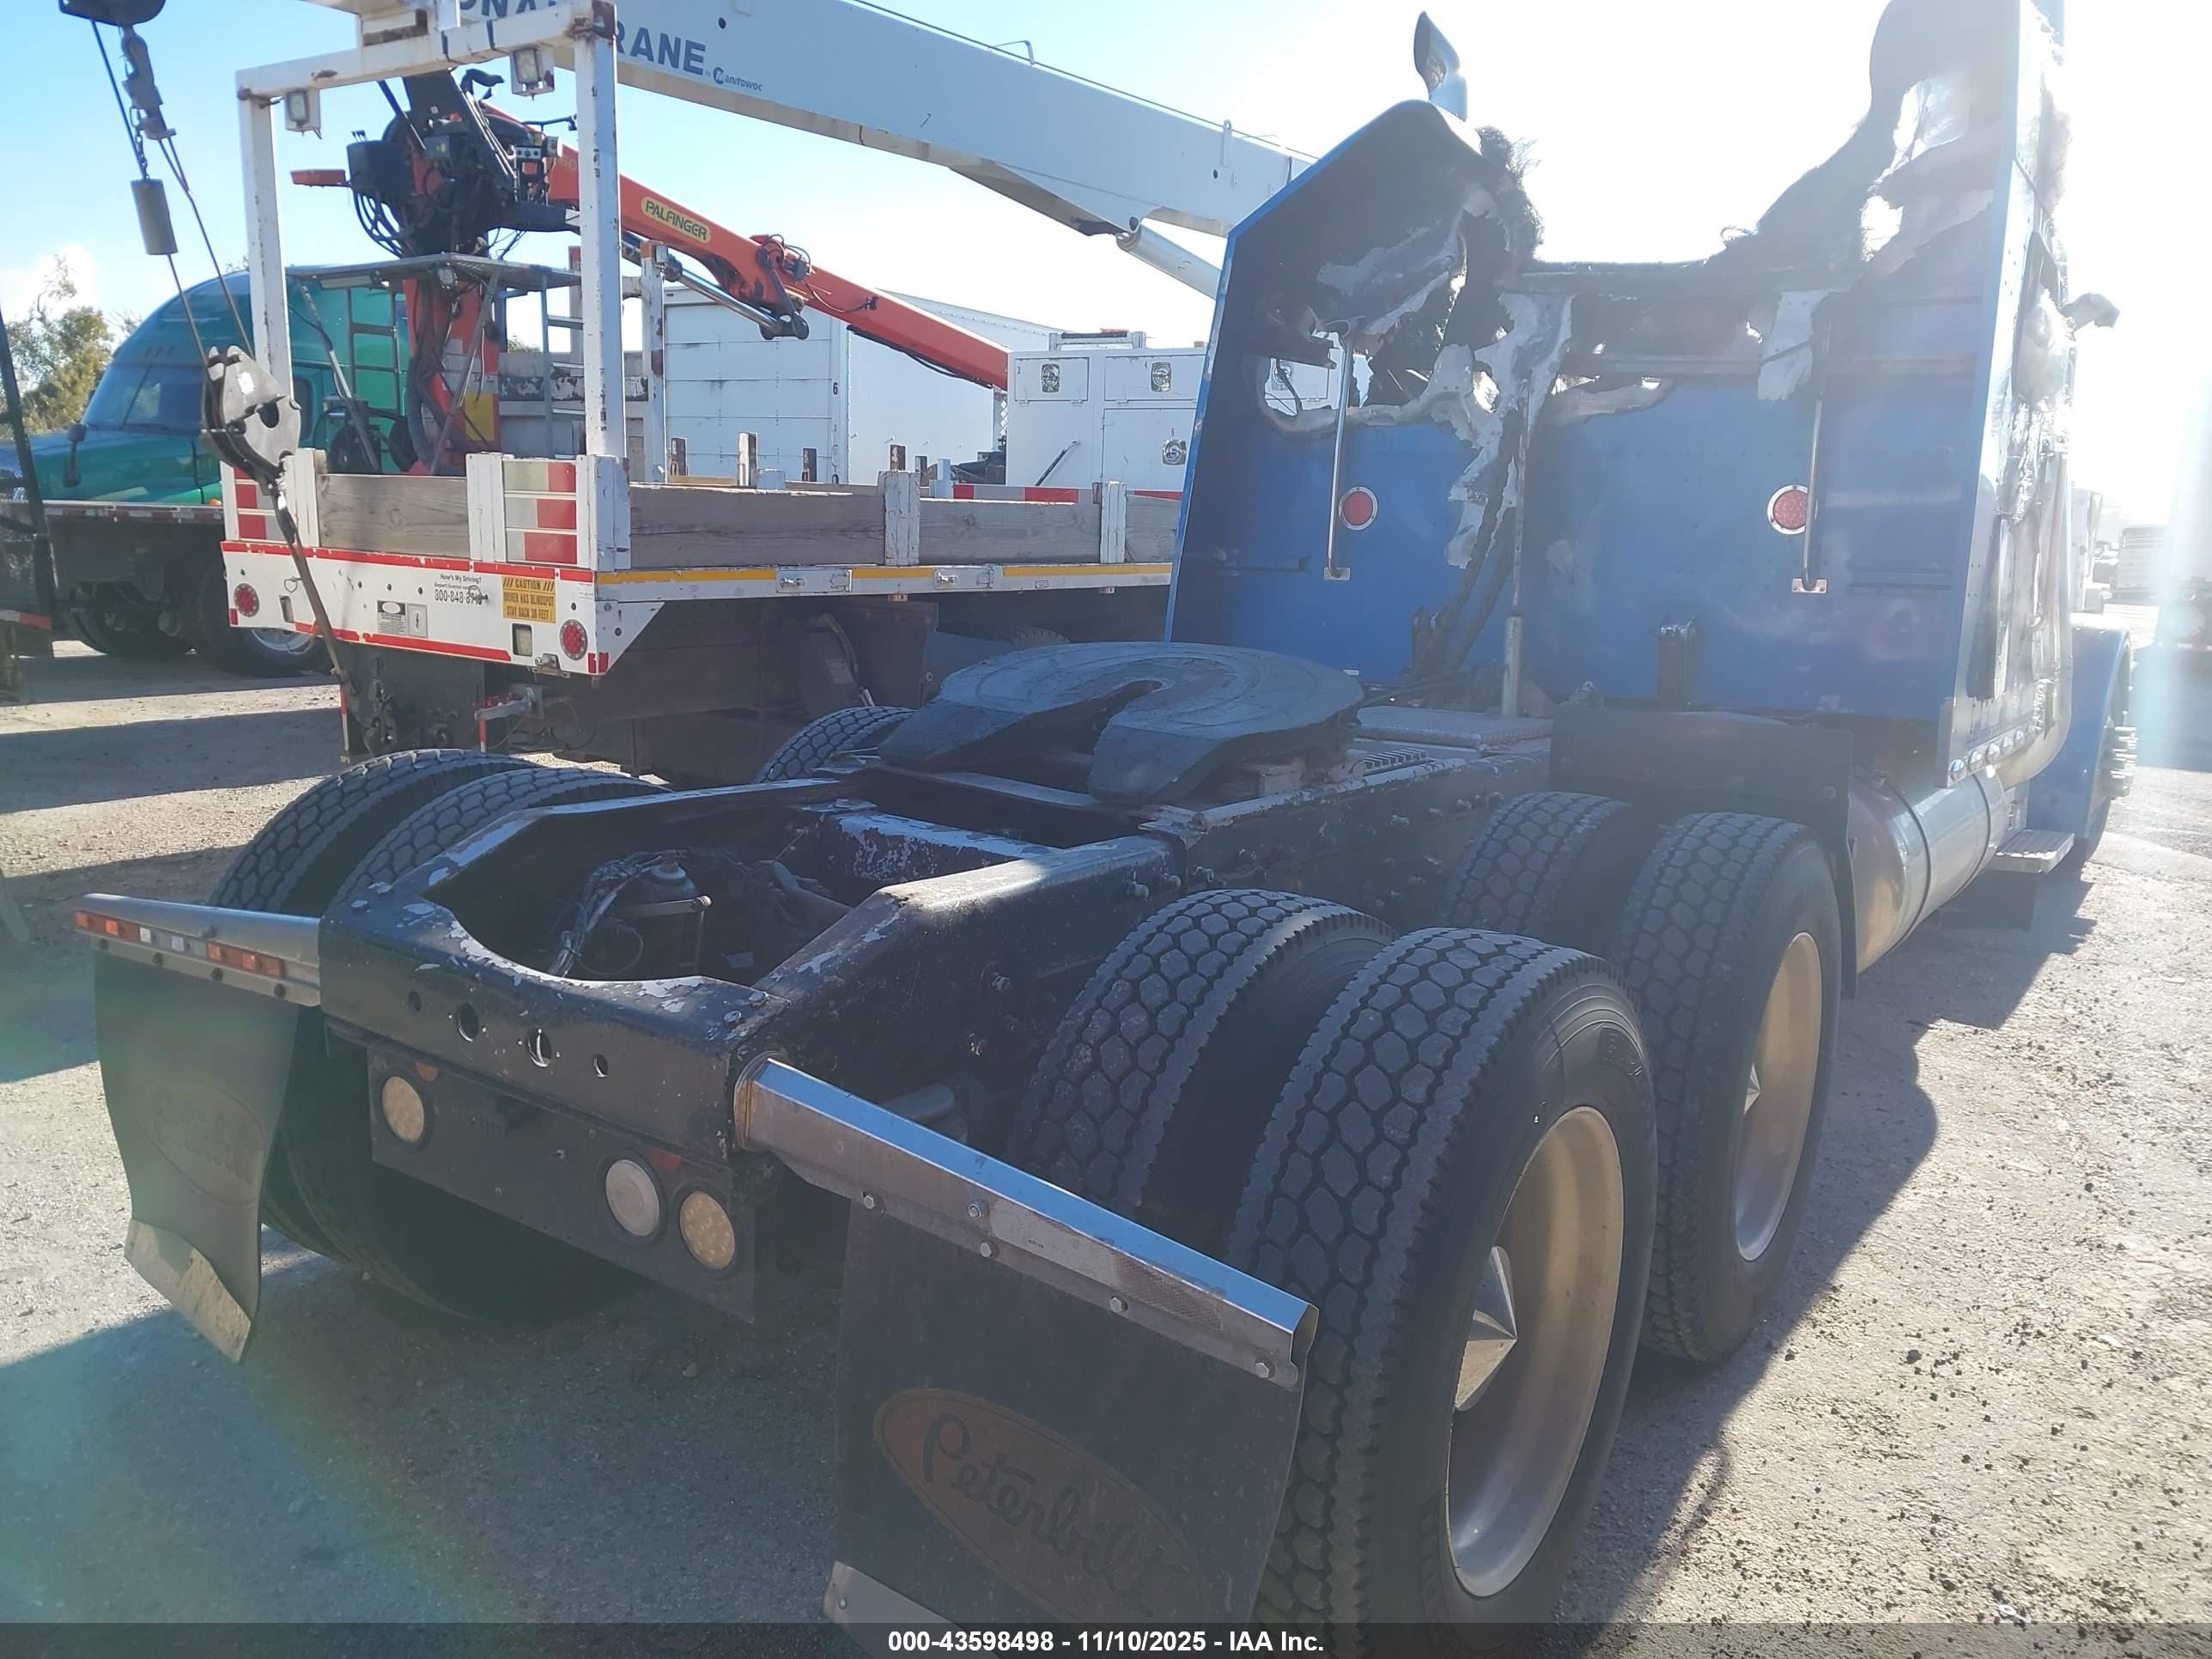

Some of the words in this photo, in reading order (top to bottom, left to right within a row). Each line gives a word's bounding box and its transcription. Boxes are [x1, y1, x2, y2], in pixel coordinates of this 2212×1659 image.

[713, 66, 763, 91] Manitowoc
[646, 199, 708, 240] PALFINGER
[516, 578, 541, 592] CAUTION
[507, 605, 517, 617] STAY
[518, 606, 530, 618] BACK
